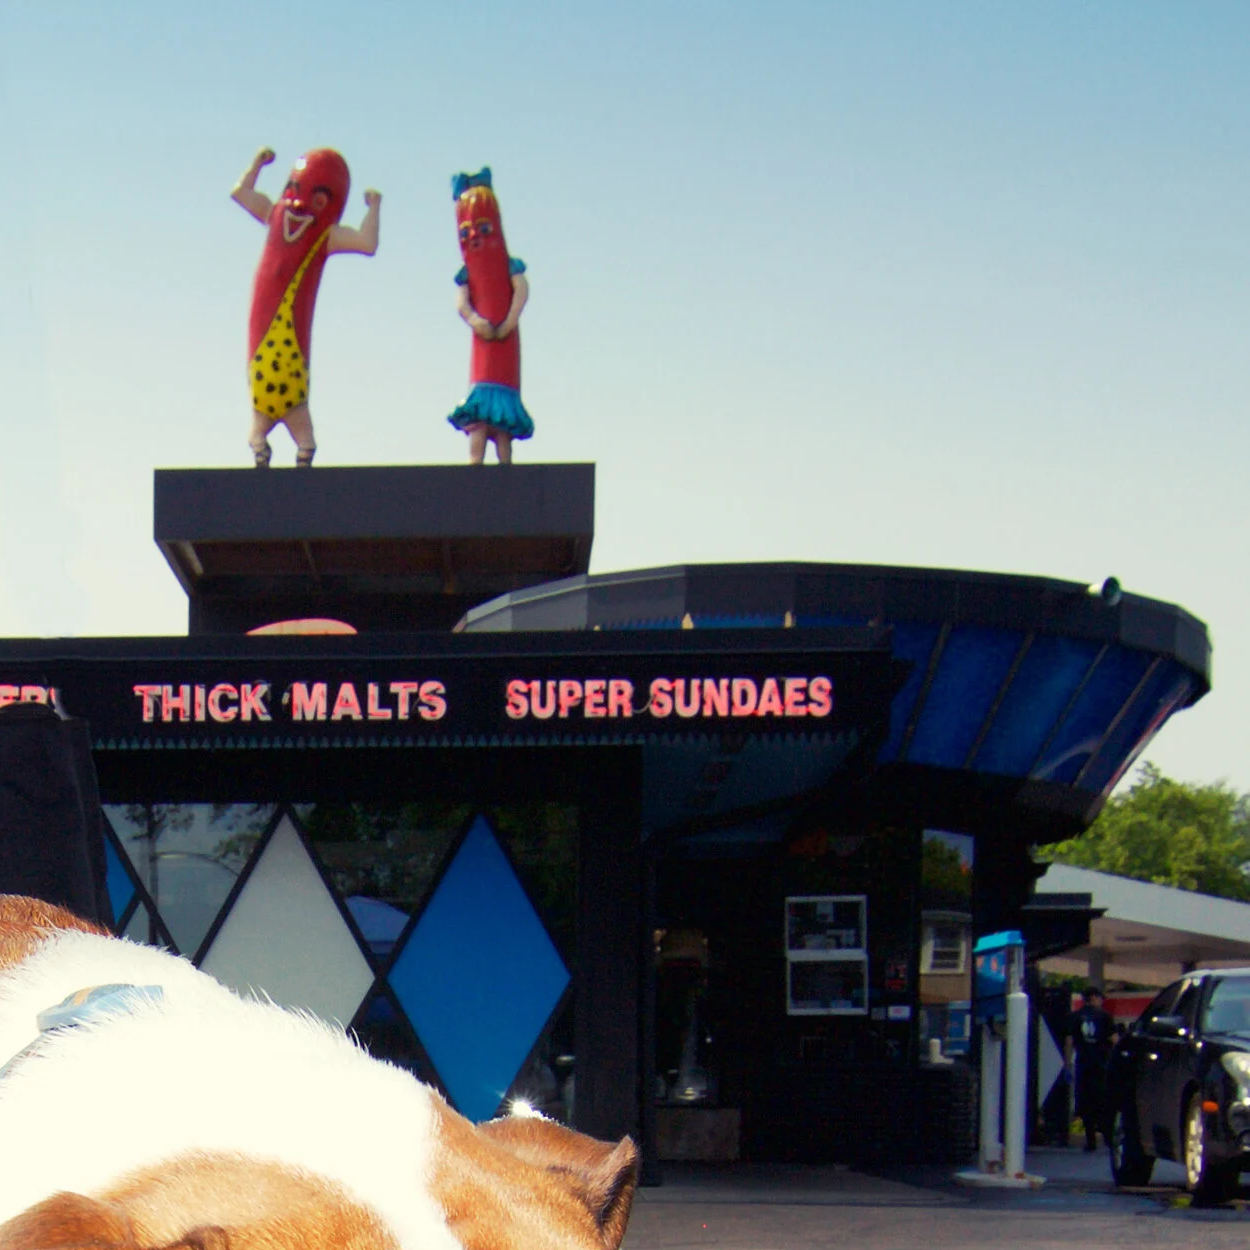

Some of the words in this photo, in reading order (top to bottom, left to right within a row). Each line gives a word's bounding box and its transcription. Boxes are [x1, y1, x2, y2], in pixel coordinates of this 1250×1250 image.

[133, 683, 272, 722] THICK
[291, 680, 447, 721] MALTS
[505, 679, 634, 719] SUPER
[650, 677, 832, 717] SUNDAES
